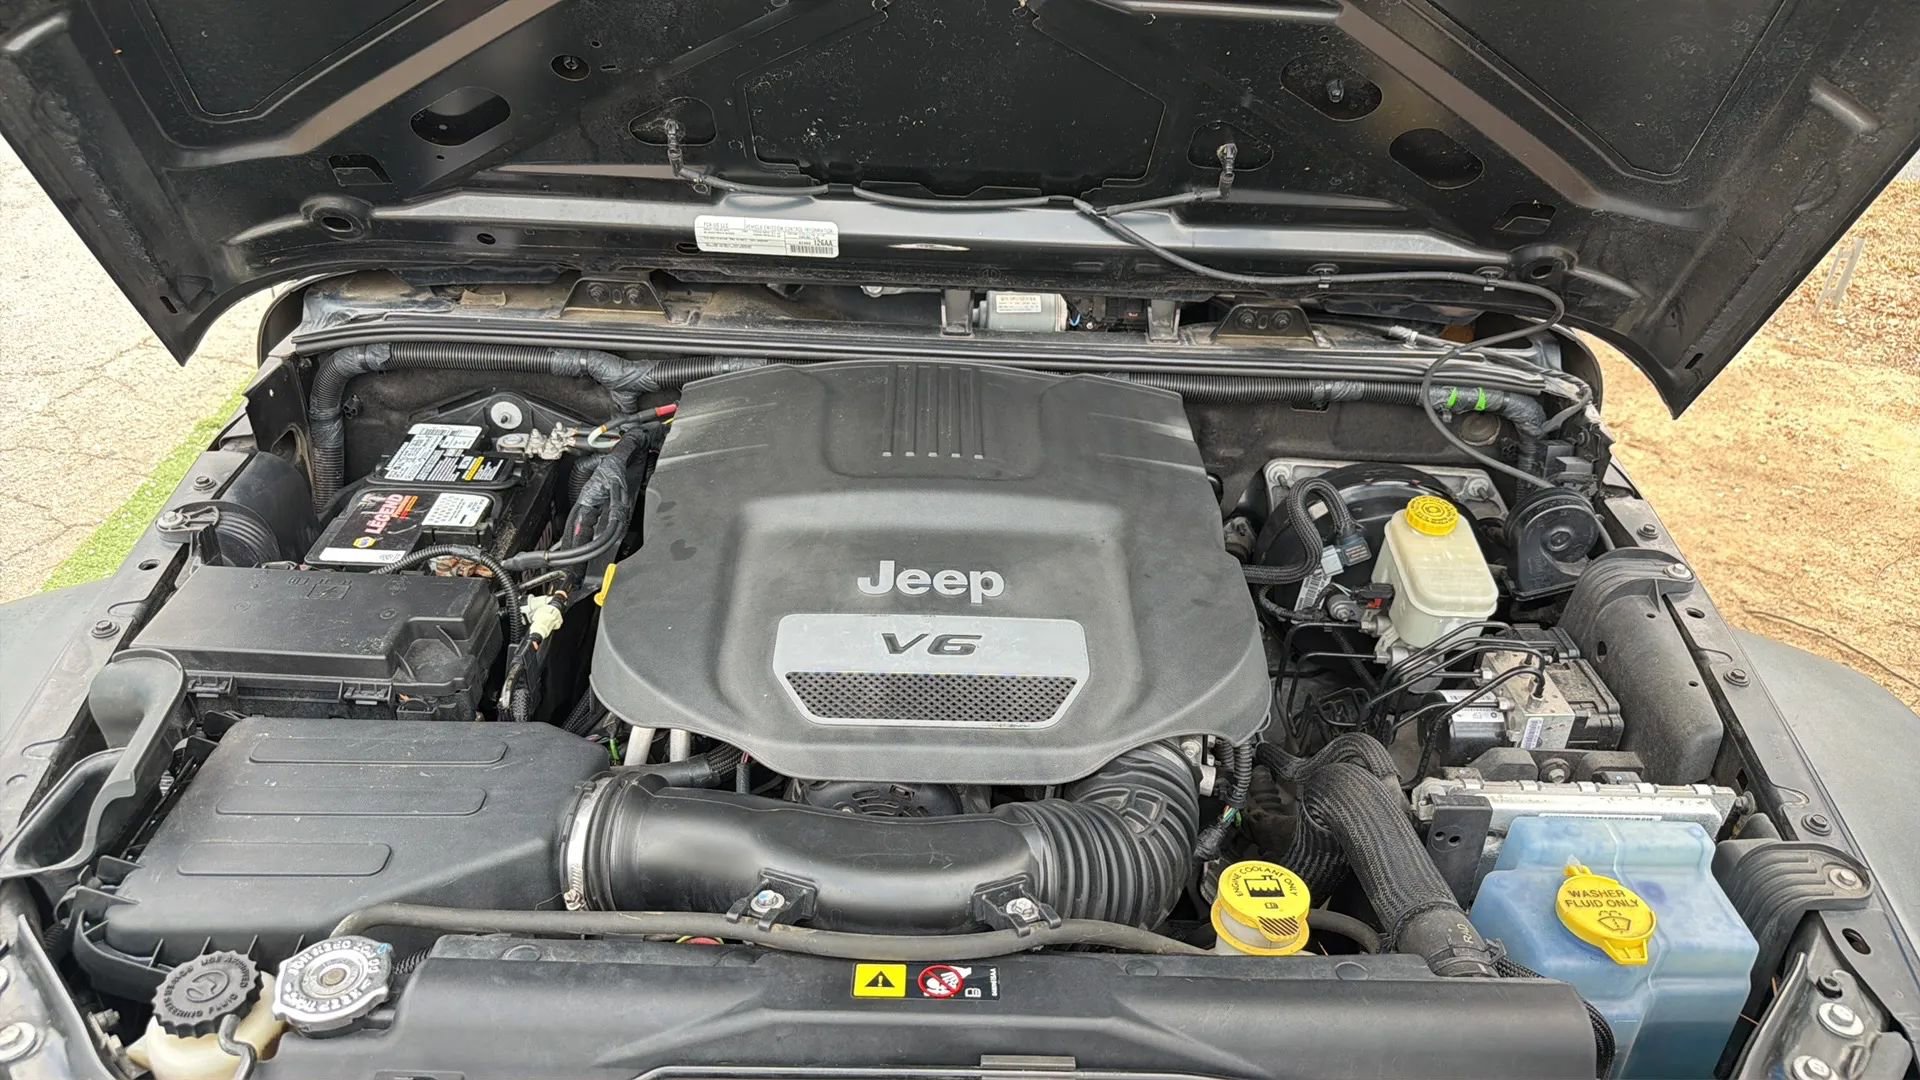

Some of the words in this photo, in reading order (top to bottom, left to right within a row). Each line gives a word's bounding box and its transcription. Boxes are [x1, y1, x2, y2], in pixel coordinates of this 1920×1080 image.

[364, 494, 404, 534] LEGEND
[857, 560, 1004, 604] Jeep
[881, 633, 983, 655] V6
[1240, 865, 1284, 877] COOLANT
[1284, 878, 1298, 896] ONLY
[1567, 889, 1626, 898] WASHER
[1564, 899, 1603, 908] FLUID
[1606, 899, 1639, 908] ONLY
[201, 955, 222, 966] USE
[224, 957, 250, 988] APPROVED
